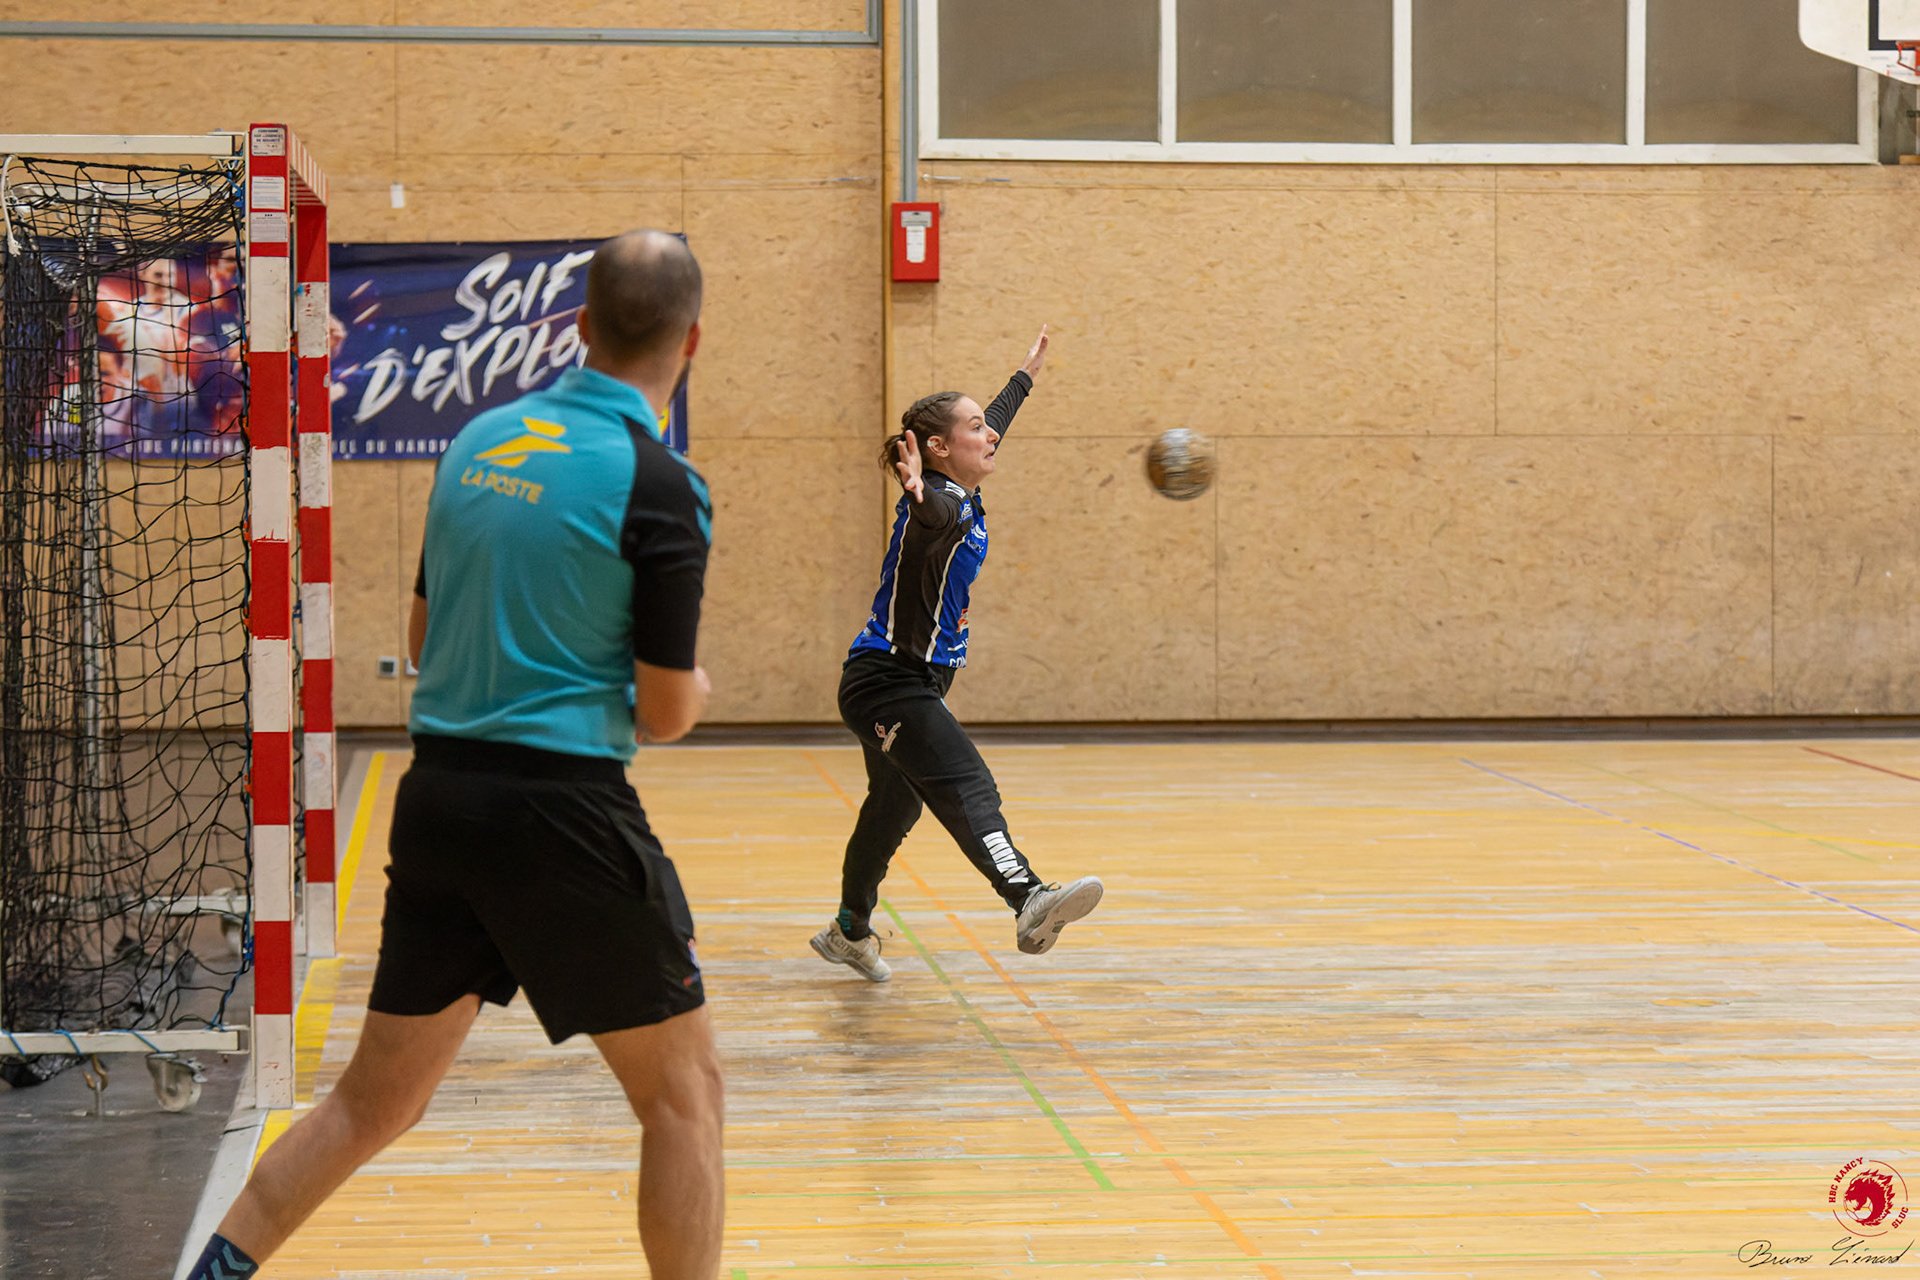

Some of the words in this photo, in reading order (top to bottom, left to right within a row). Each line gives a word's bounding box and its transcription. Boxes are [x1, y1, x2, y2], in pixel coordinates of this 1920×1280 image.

[365, 438, 387, 454] DU
[394, 438, 456, 454] HANDB
[460, 466, 484, 487] LA
[484, 471, 545, 505] POSTE
